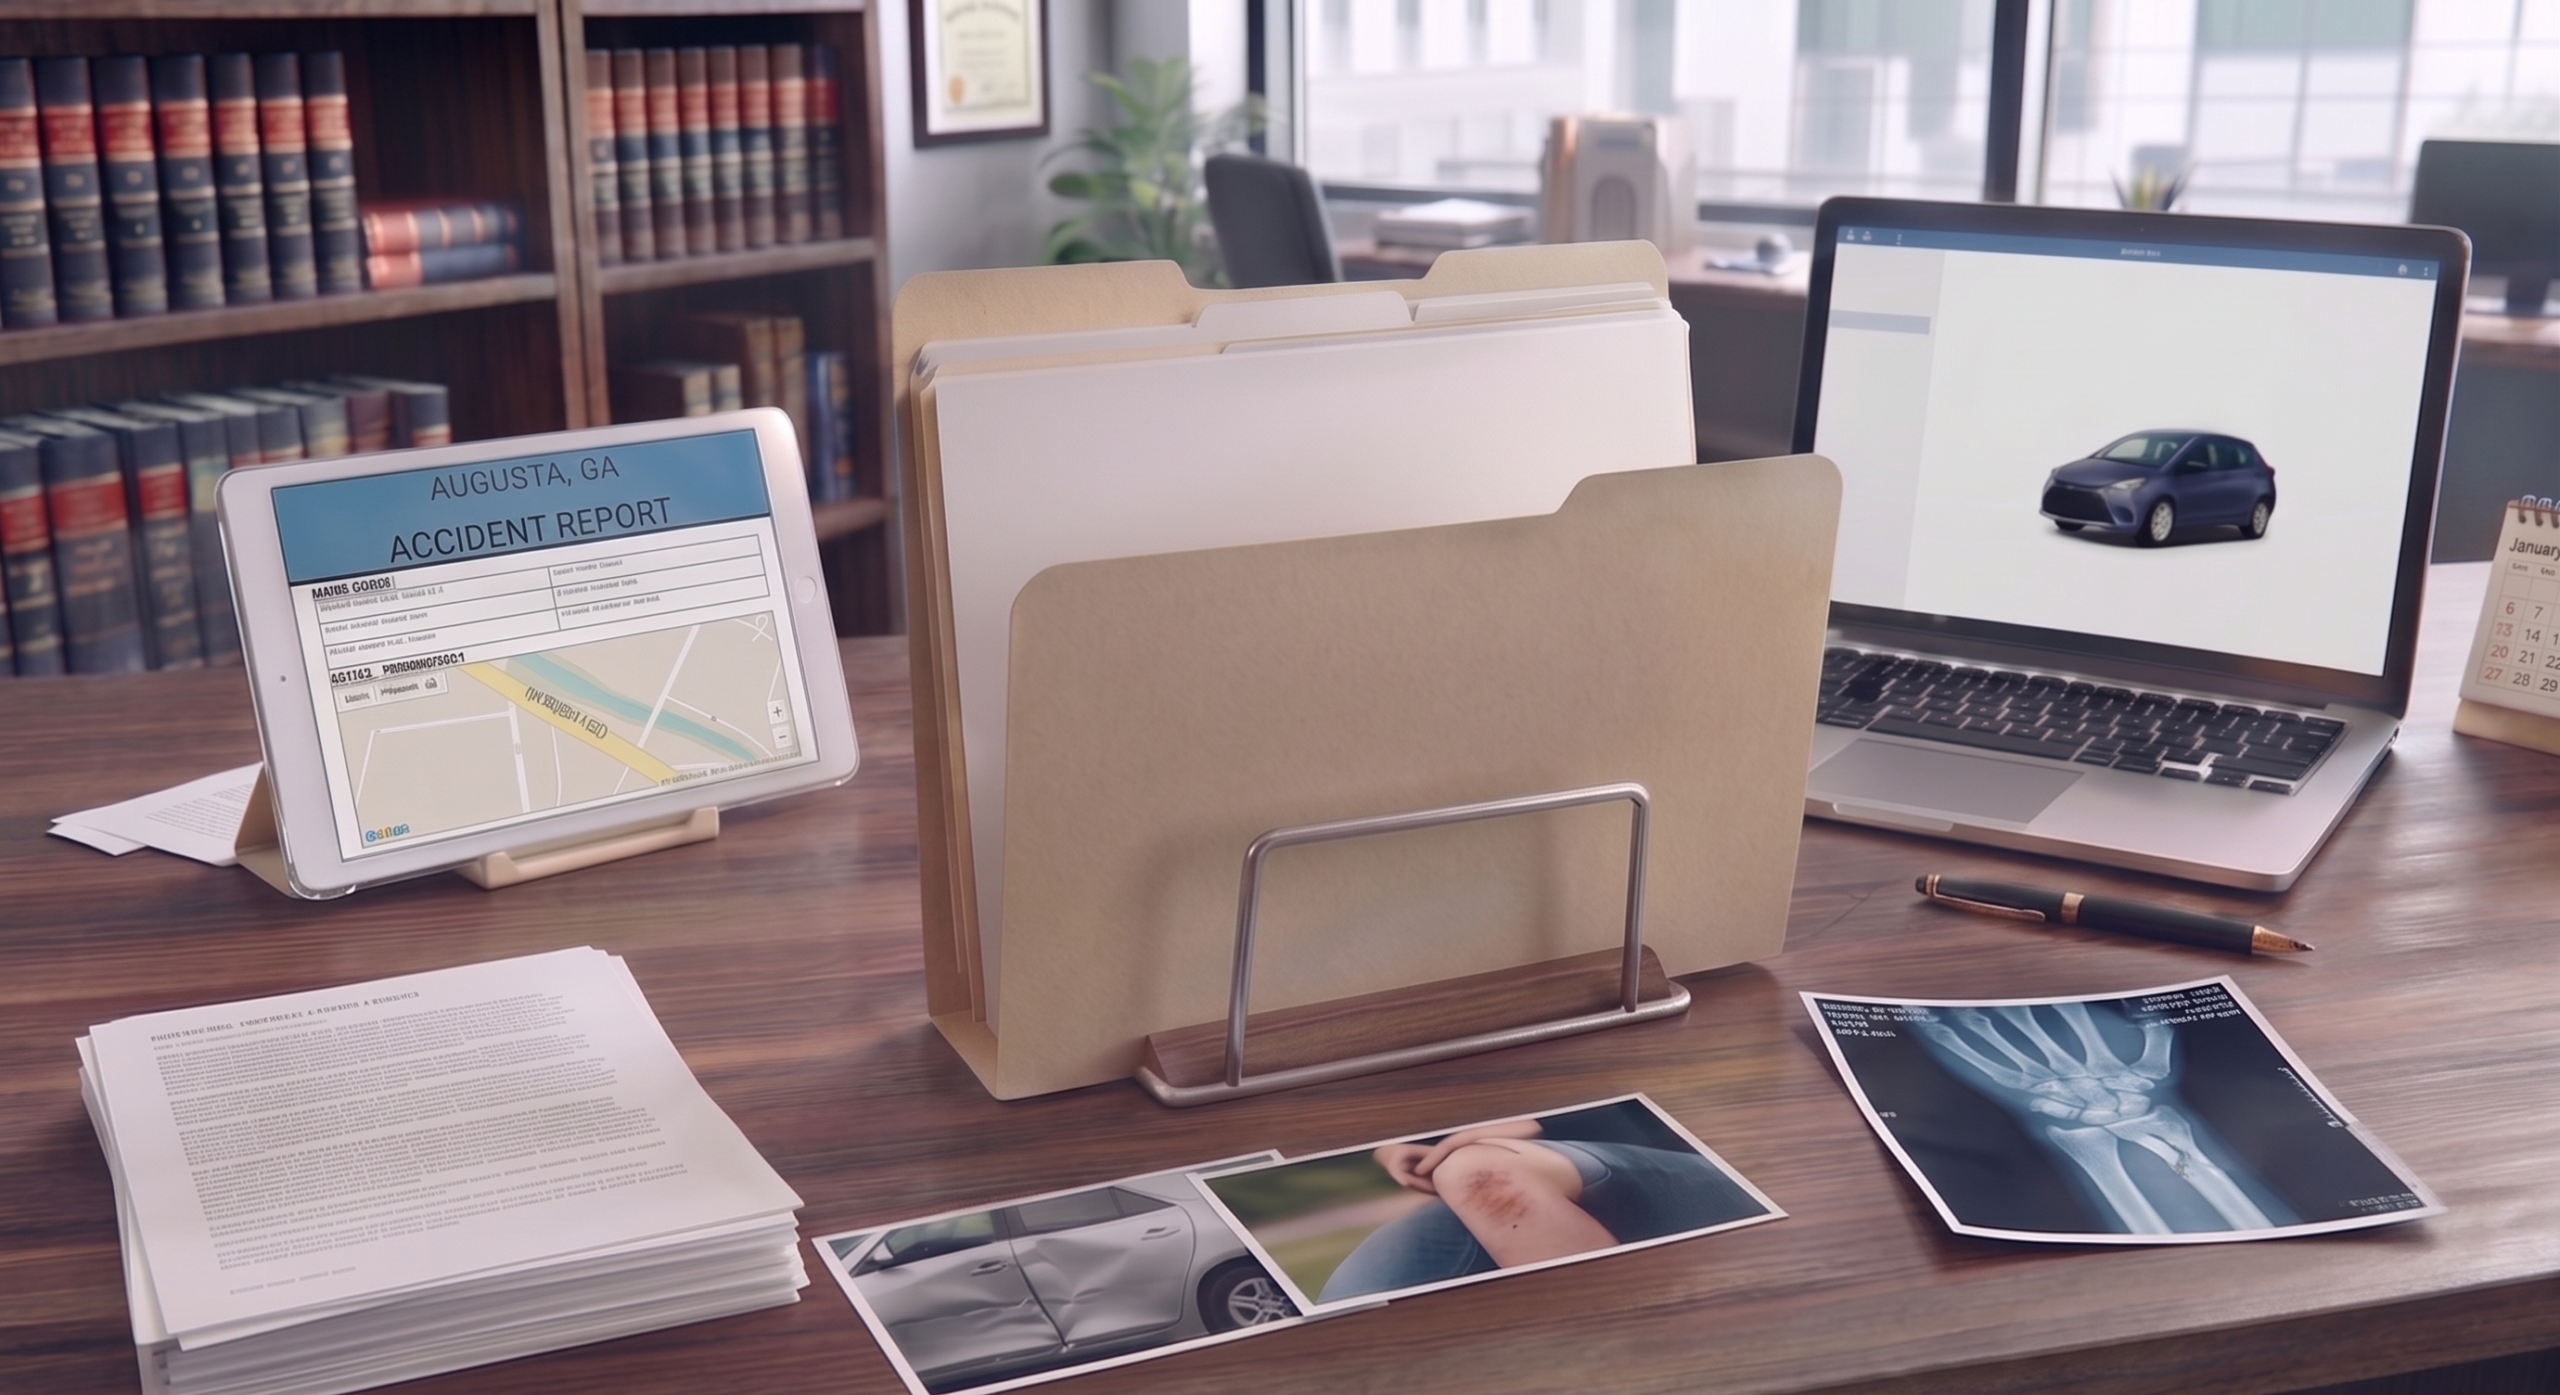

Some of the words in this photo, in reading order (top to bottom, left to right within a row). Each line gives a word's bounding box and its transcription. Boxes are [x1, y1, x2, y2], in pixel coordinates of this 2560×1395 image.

[431, 461, 572, 501] AUGUSTA,
[580, 455, 620, 481] GA
[389, 514, 546, 564] ACCIDENT
[556, 496, 671, 539] REPORT
[2506, 602, 2515, 615] 6
[2534, 606, 2543, 619] 7
[2525, 628, 2541, 643] 14
[2490, 644, 2509, 659] 20
[2518, 650, 2535, 665] 21
[2484, 667, 2503, 681] 27
[2512, 672, 2531, 687] 28
[2539, 677, 2559, 693] 29
